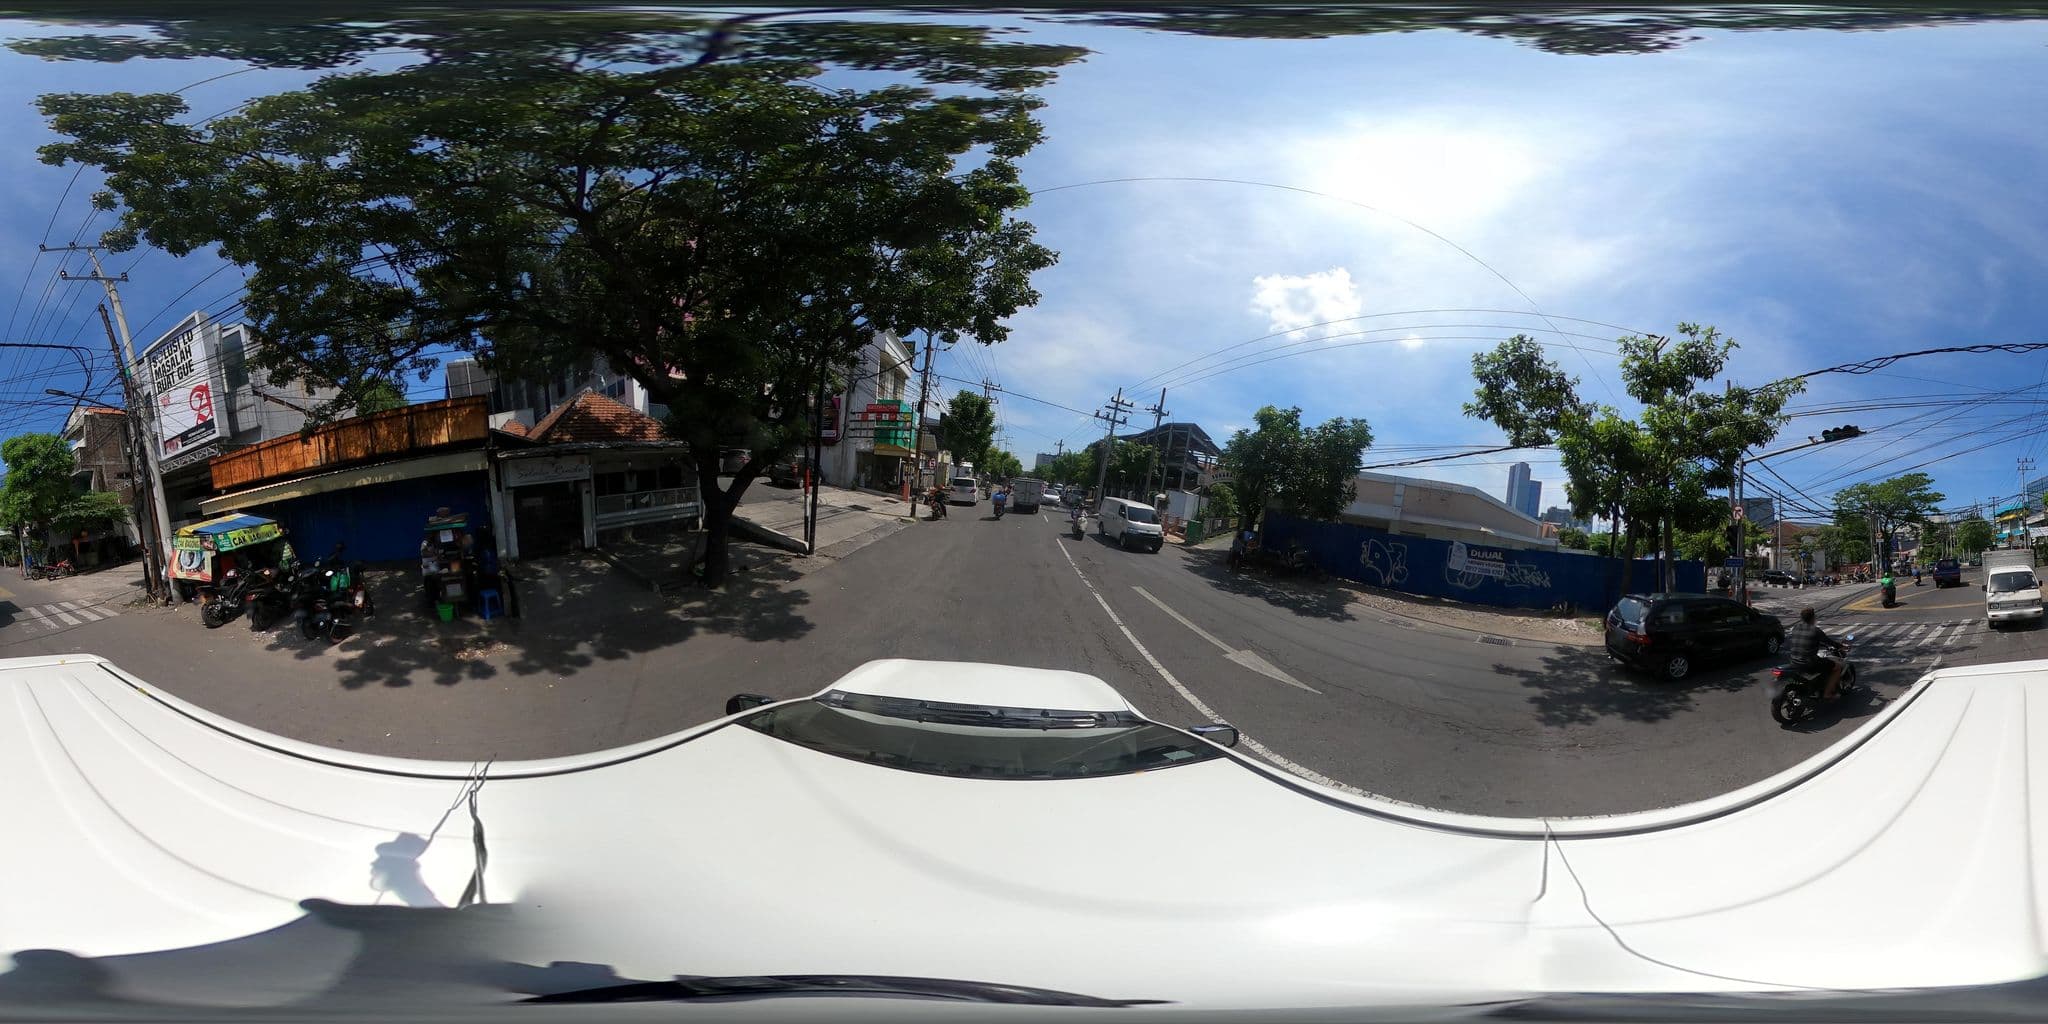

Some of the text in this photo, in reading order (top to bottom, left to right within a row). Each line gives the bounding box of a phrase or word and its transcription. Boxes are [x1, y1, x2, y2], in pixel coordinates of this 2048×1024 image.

[154, 345, 192, 380] MASALAH
[157, 359, 195, 395] BUAT GUE
[1470, 549, 1504, 560] DIJUAL
